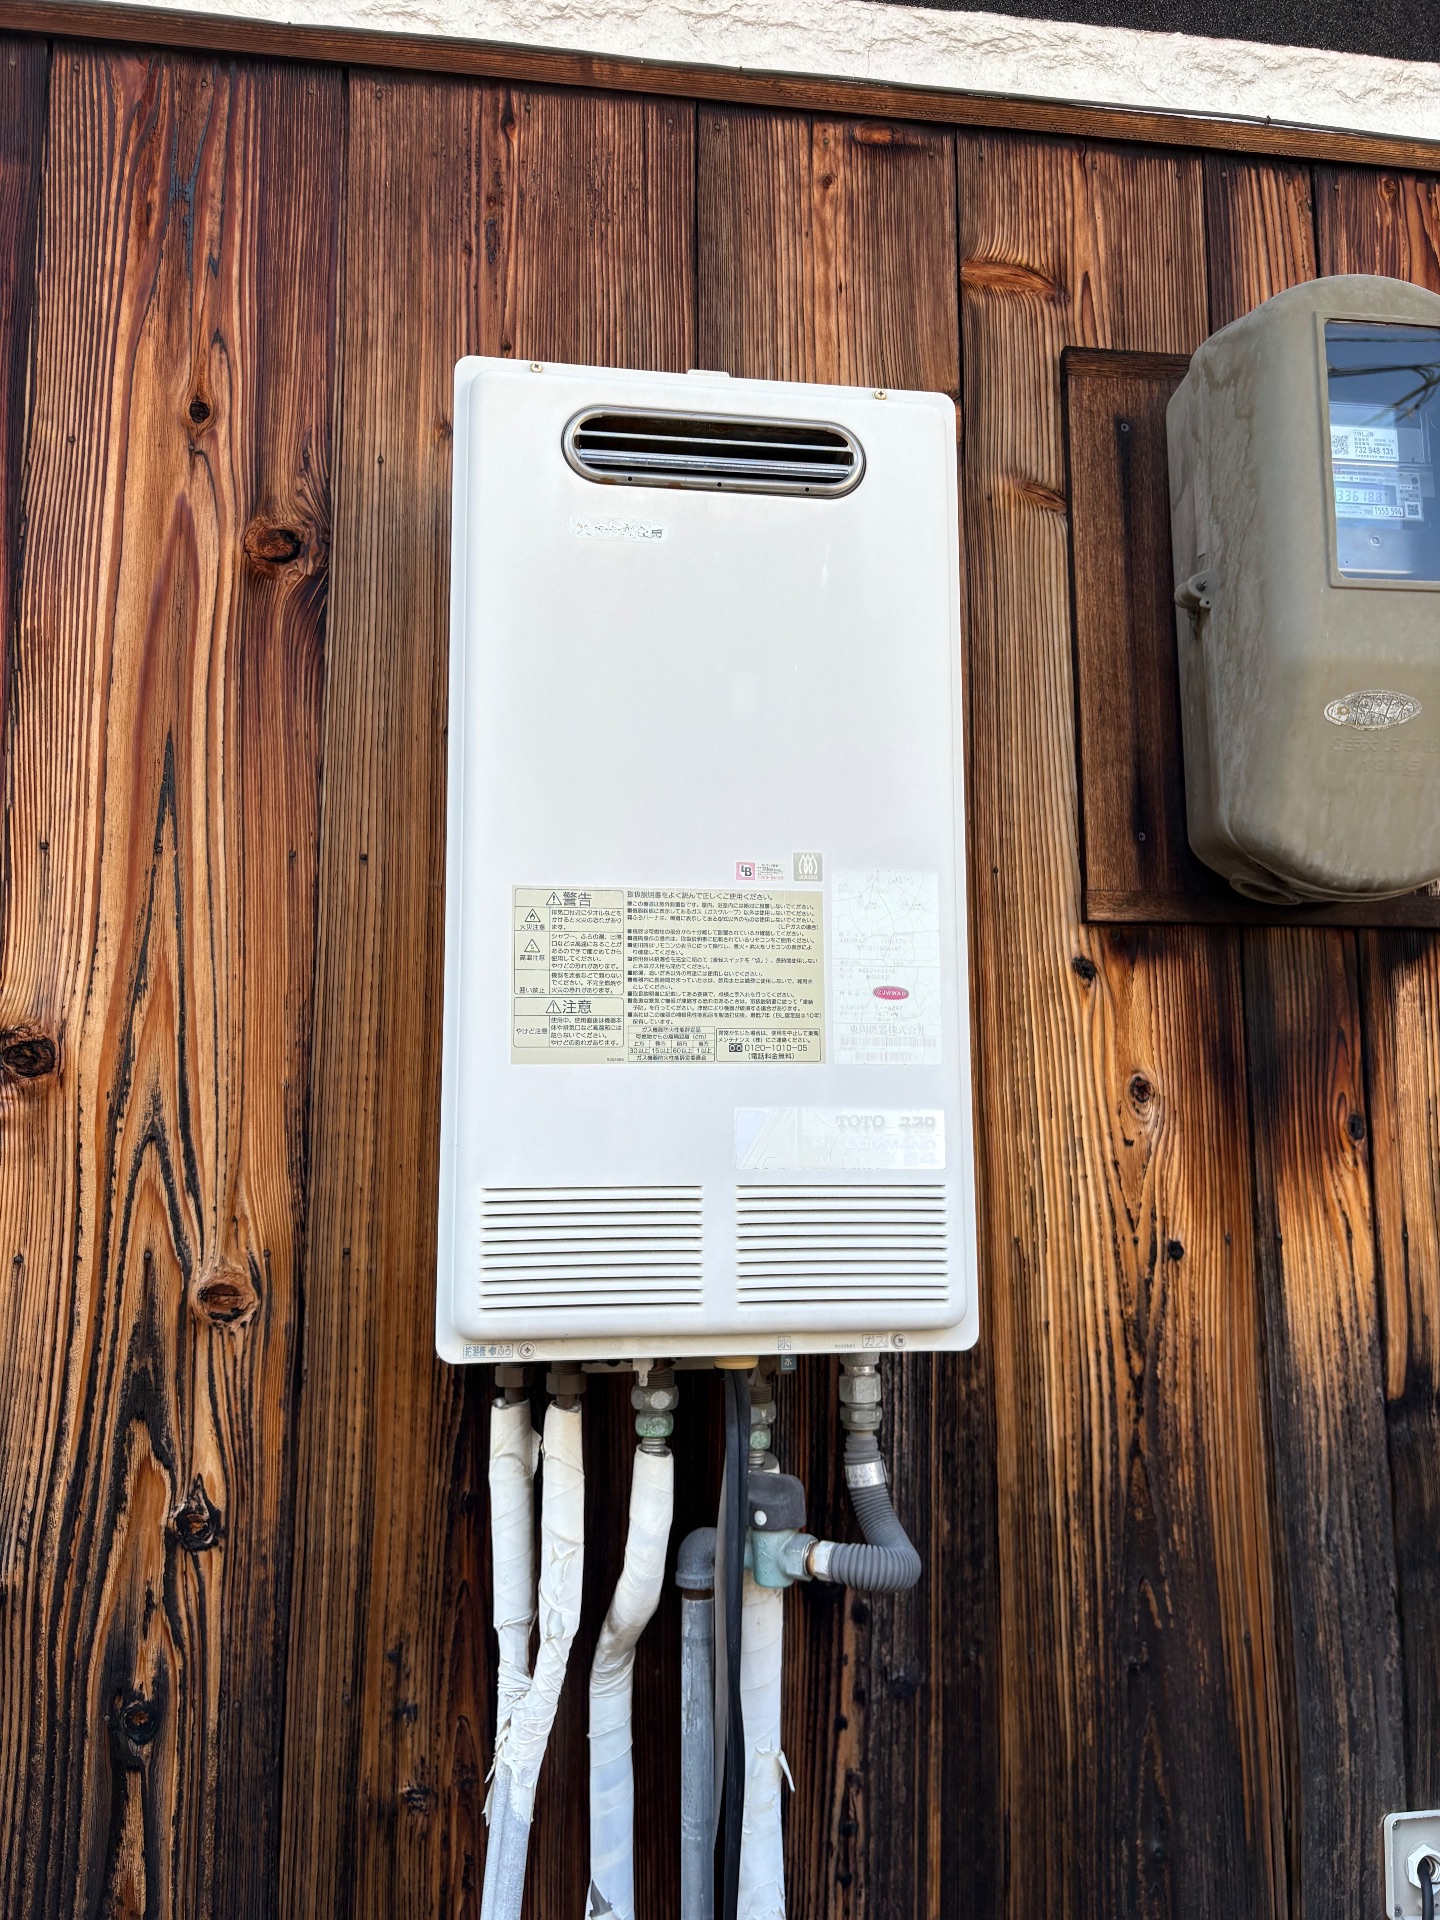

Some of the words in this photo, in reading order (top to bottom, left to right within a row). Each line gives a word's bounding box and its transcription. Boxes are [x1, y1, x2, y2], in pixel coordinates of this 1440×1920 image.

[1354, 446, 1367, 454] 732
[1382, 448, 1394, 456] 131
[563, 891, 592, 907] 警告
[562, 999, 592, 1014] 注意
[744, 1044, 808, 1052] 0120-1010-05
[835, 1115, 886, 1129] TOTO
[864, 1335, 885, 1346] ガス
